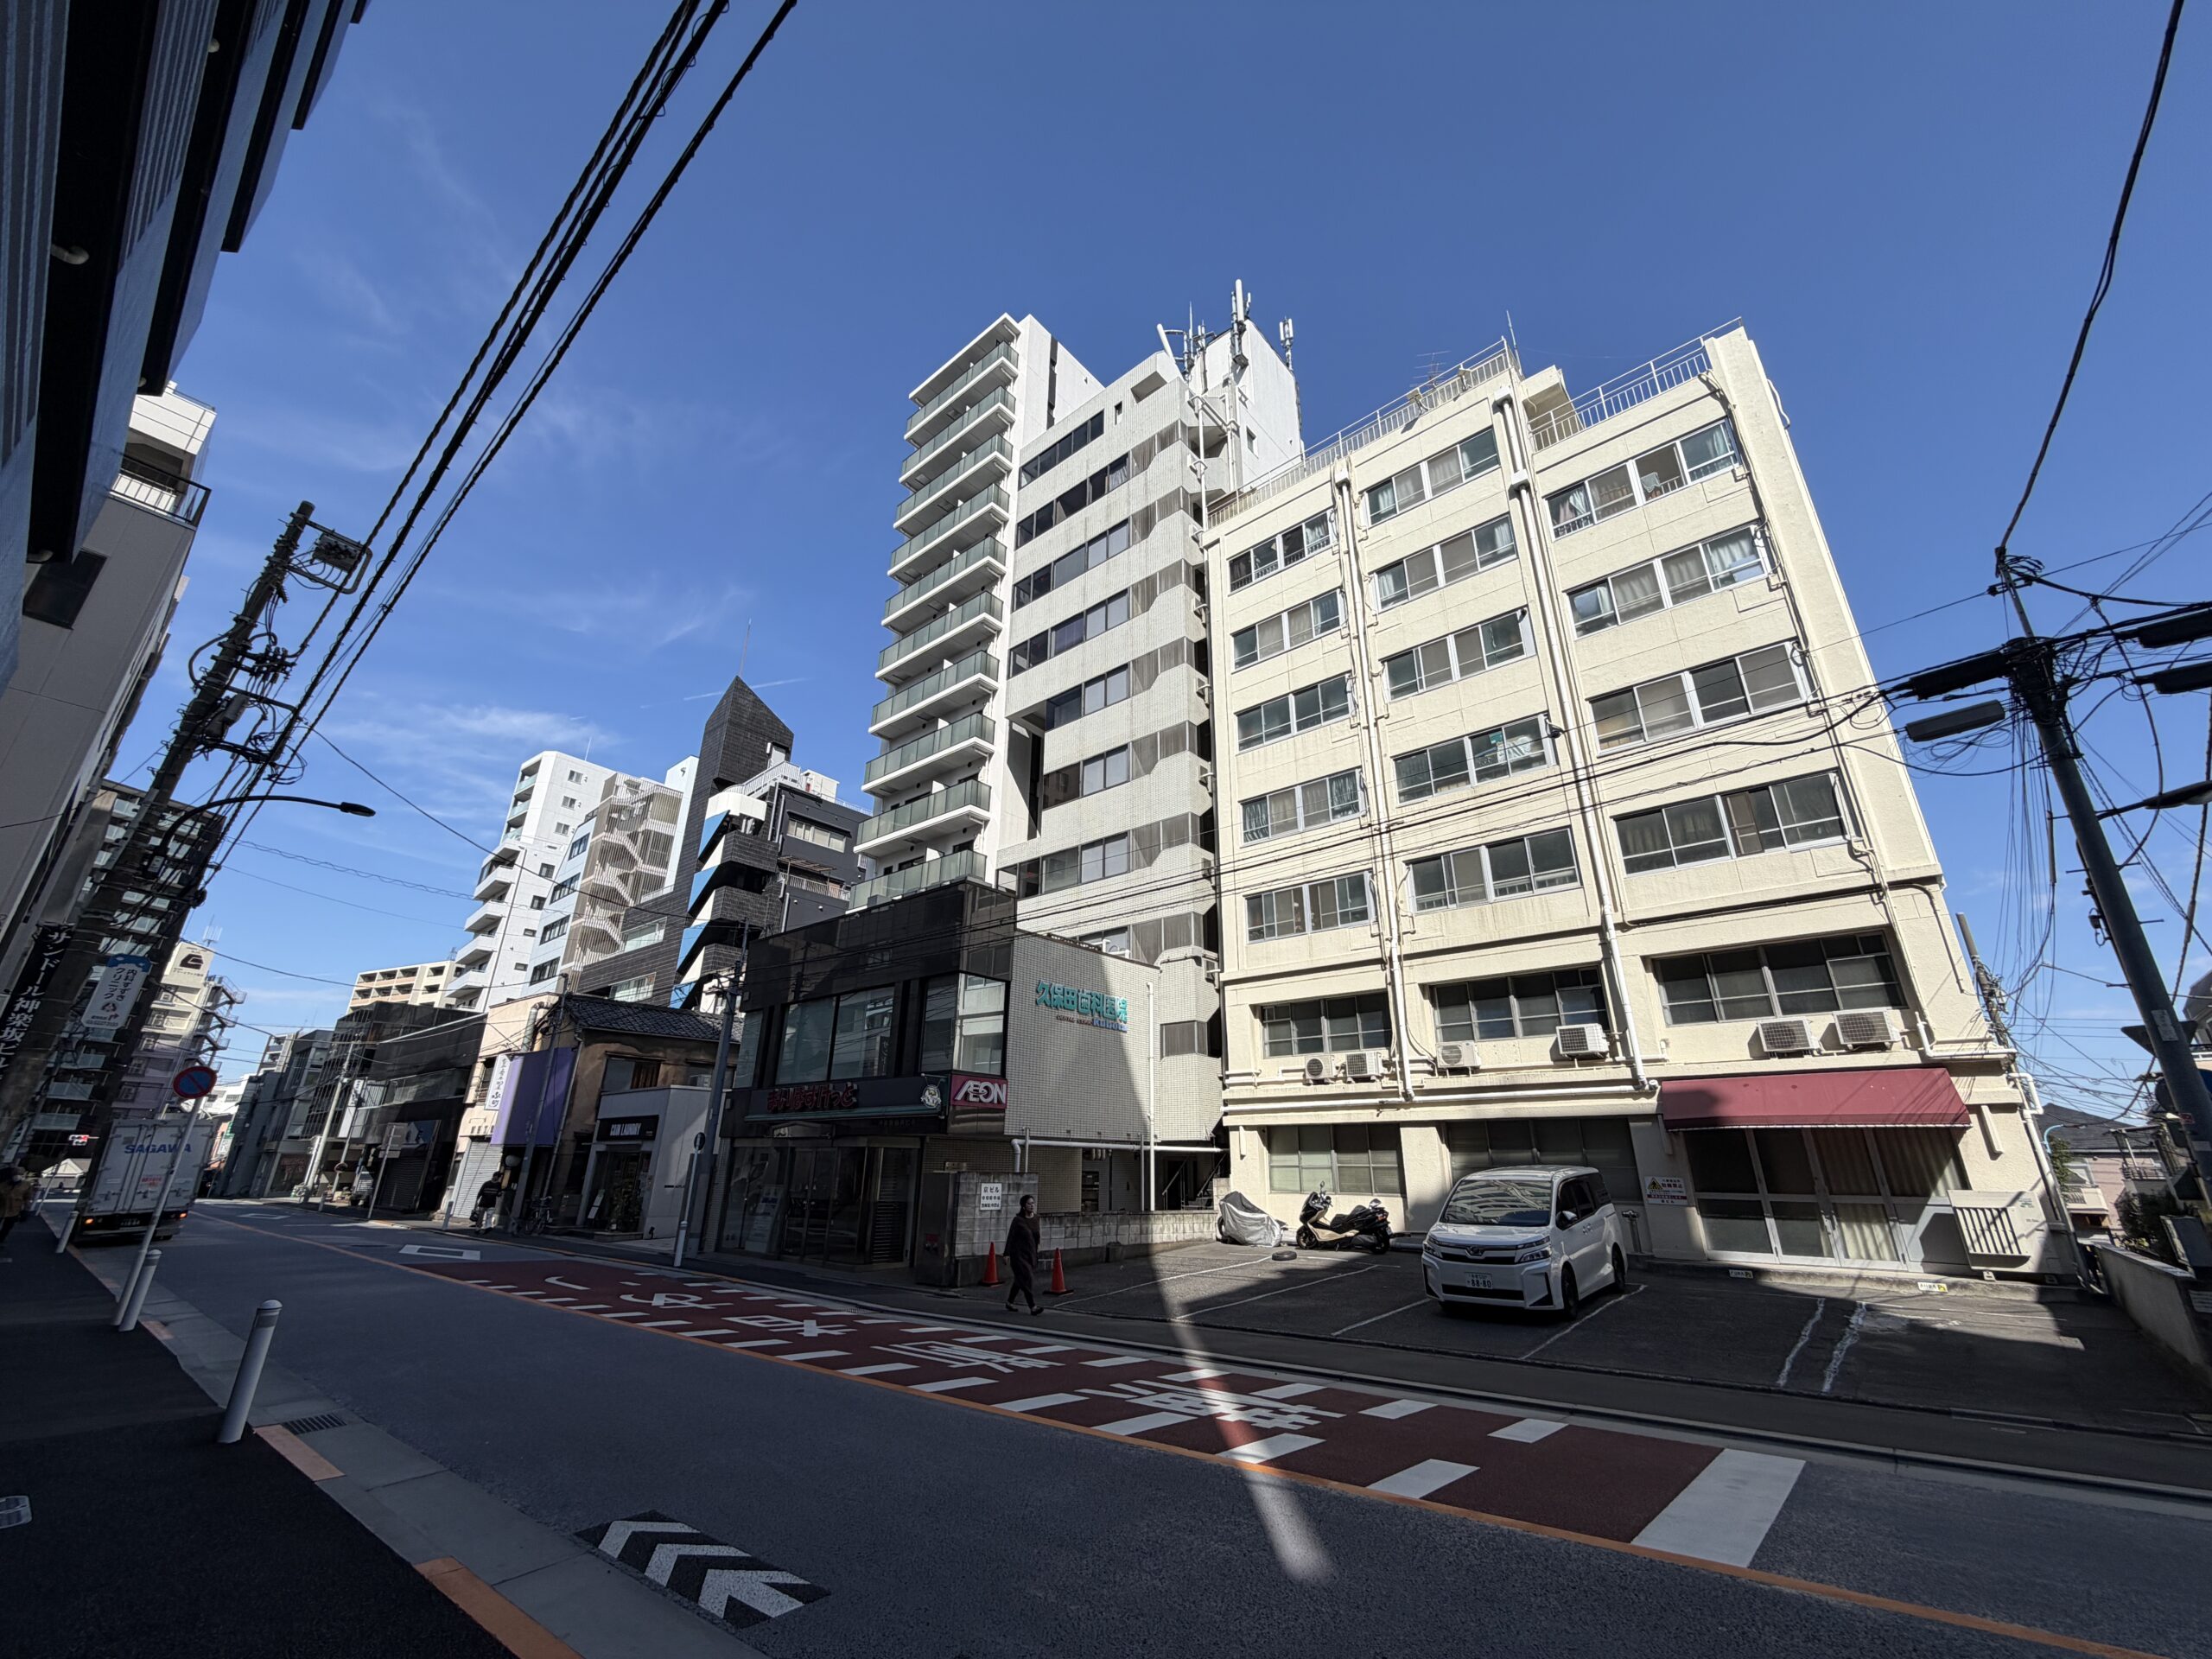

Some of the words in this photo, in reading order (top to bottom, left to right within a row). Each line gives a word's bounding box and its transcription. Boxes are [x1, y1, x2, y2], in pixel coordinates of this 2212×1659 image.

[104, 967, 125, 1000] クリニック
[115, 969, 138, 1001] 内科すずき
[1035, 979, 1128, 1024] 久保田歯科医院
[1092, 1018, 1128, 1033] Kubota
[766, 1082, 859, 1113] まいばすけっと
[620, 1122, 642, 1135] LAUNDRY
[124, 1143, 192, 1154] SAGAWA
